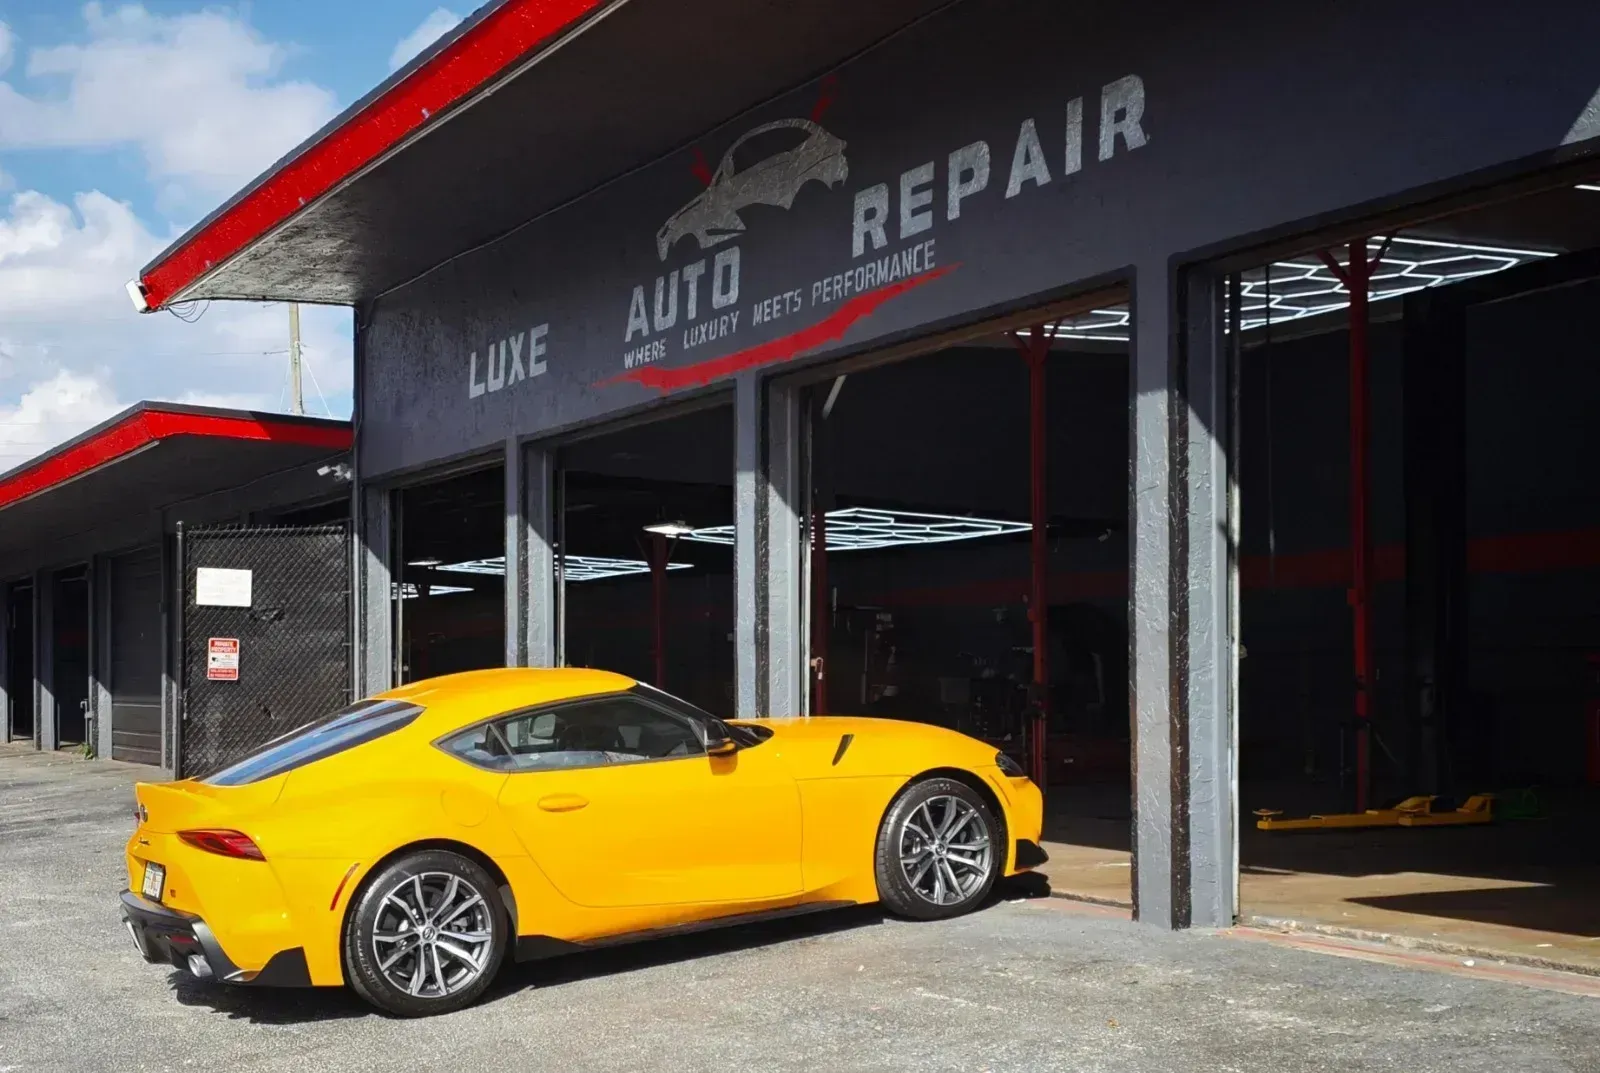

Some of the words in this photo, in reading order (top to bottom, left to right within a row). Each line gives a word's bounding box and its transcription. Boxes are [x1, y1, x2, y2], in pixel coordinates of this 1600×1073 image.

[469, 323, 549, 399] LUXE
[624, 246, 741, 342] AUTO
[852, 74, 1148, 258] REPAIR
[624, 338, 667, 369] WHERE
[683, 311, 740, 350] LUXURY
[753, 288, 802, 326] MEETS
[812, 239, 936, 307] PERFORMANCE
